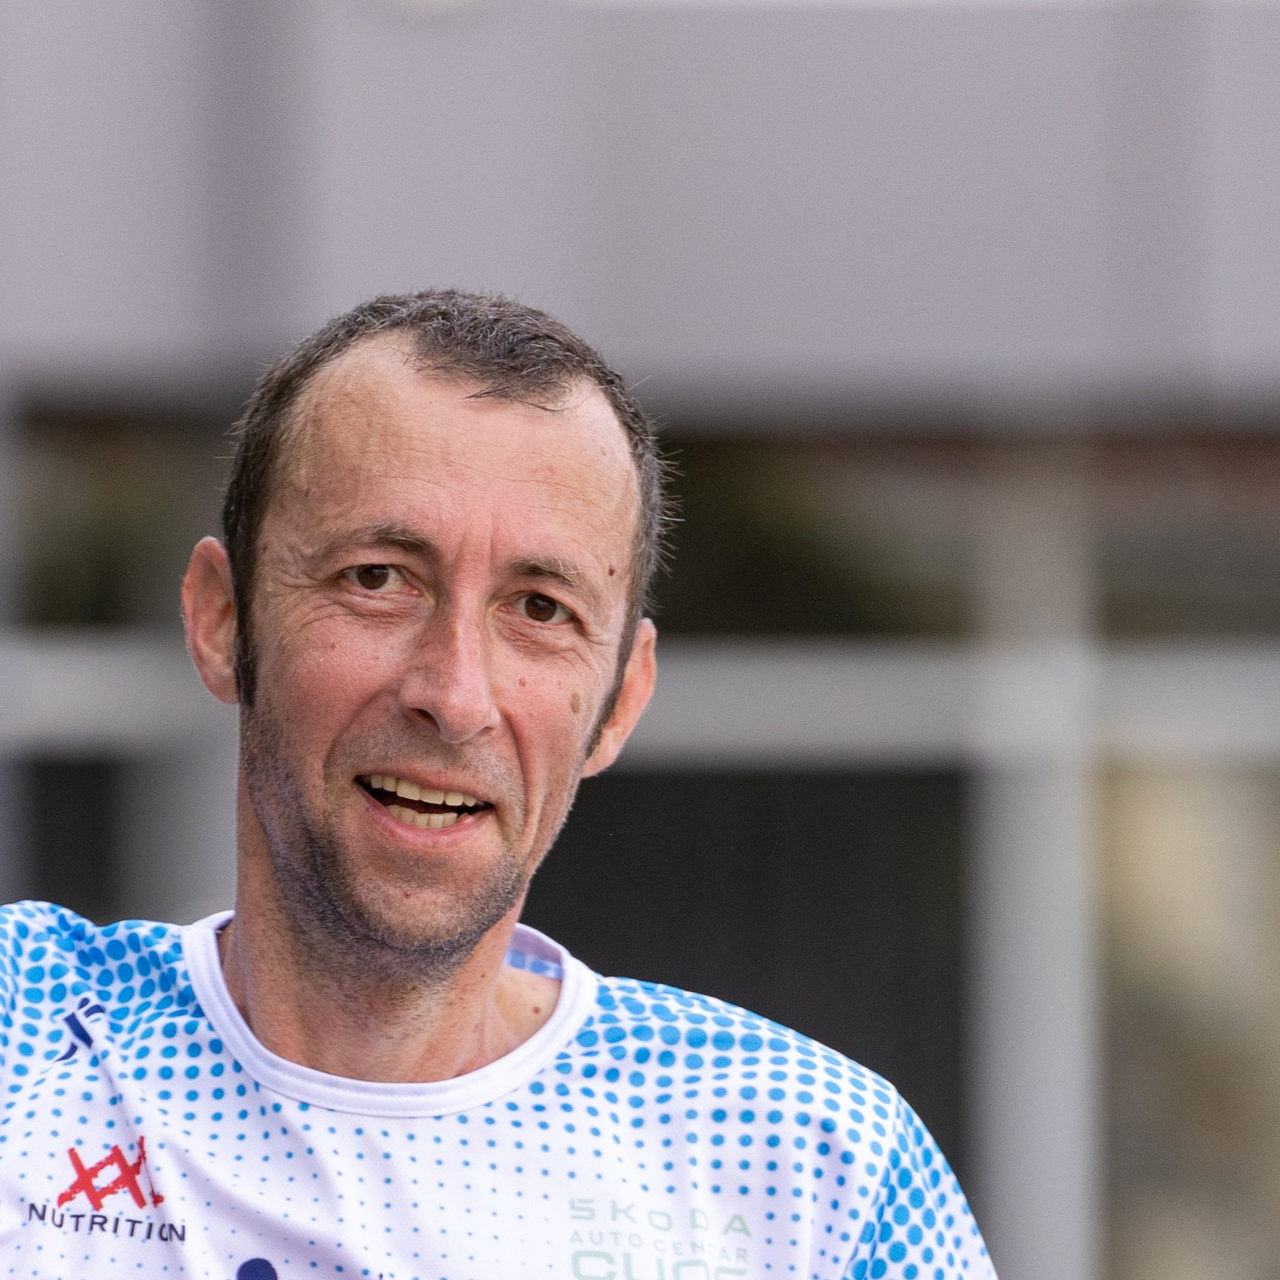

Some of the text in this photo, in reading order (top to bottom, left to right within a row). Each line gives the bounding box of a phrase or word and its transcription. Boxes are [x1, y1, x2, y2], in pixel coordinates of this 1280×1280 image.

[28, 1203, 186, 1242] NUTRITION
[570, 1230, 749, 1264] AUTO CENAR
